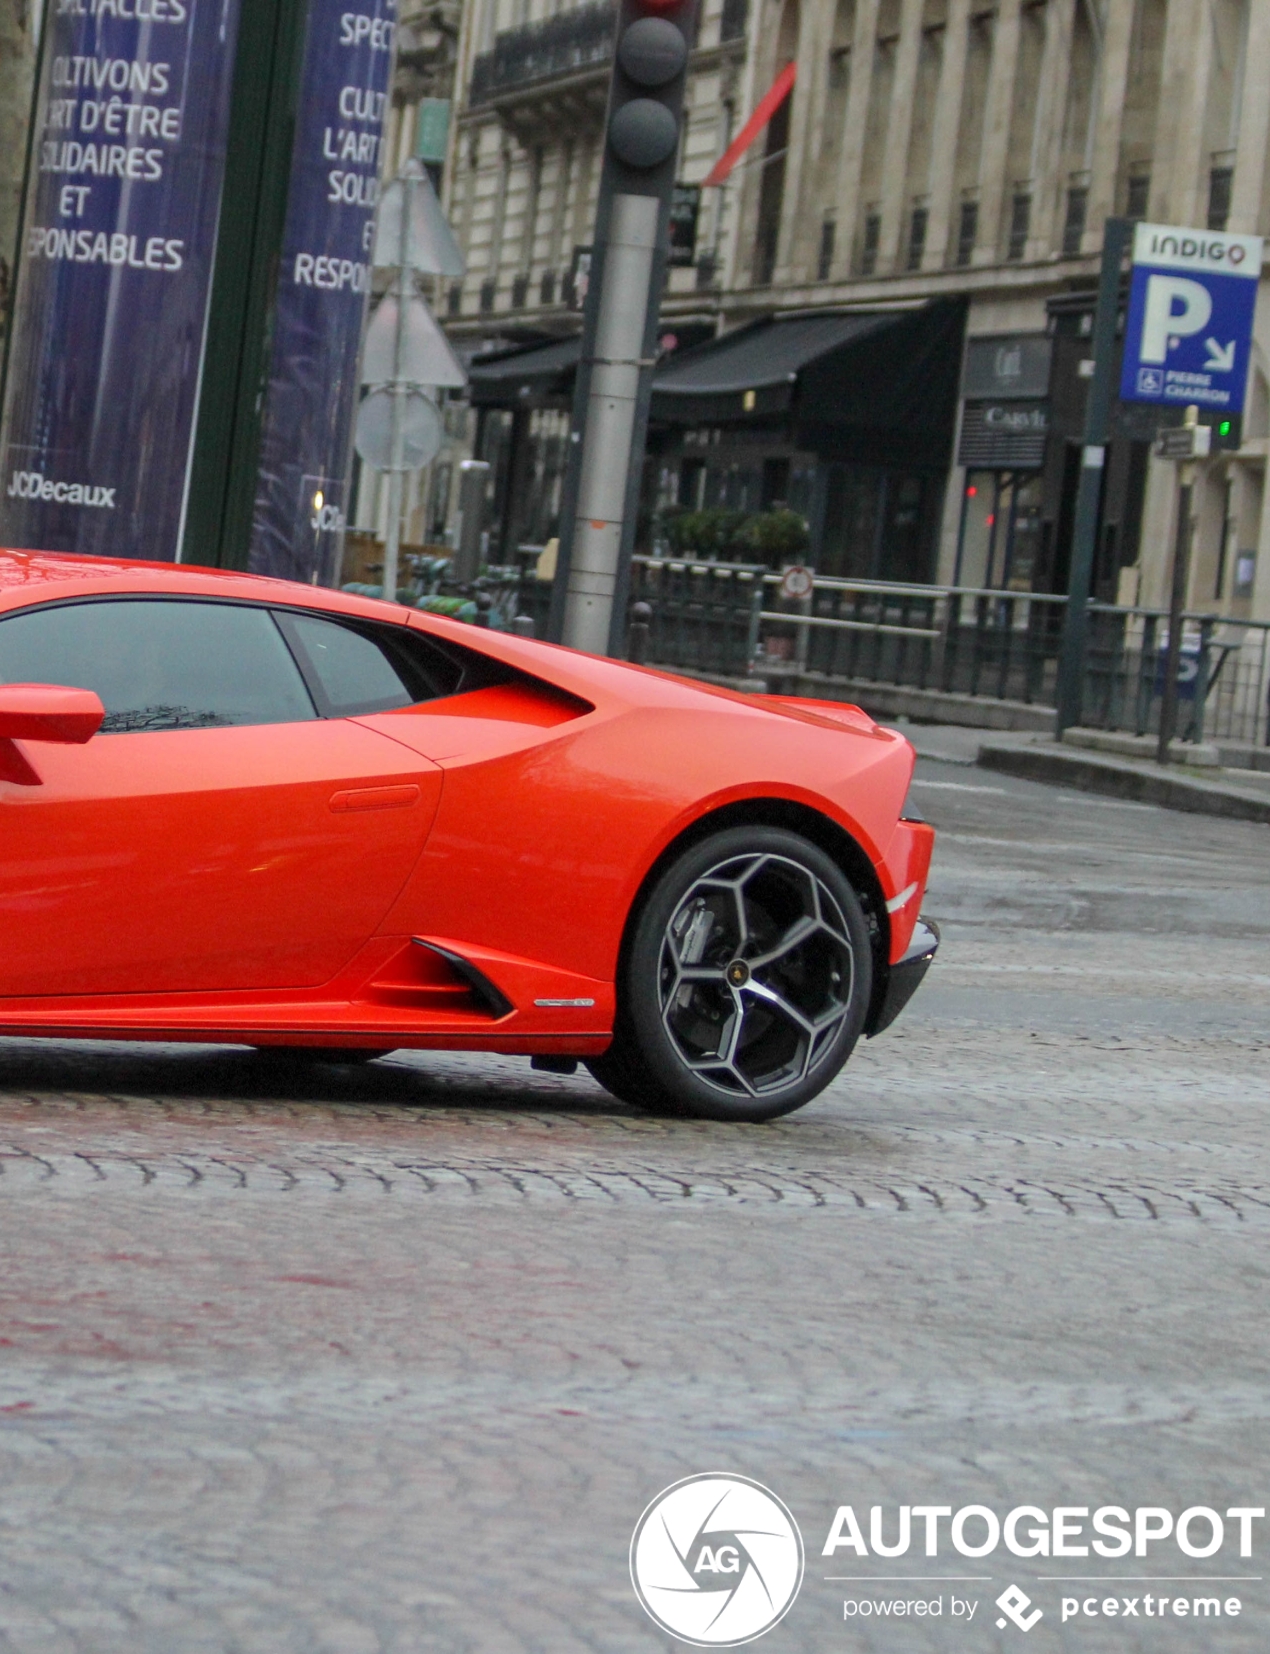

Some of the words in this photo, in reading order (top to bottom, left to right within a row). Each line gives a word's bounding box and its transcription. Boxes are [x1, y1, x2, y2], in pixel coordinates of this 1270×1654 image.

[81, 95, 180, 141] D'ÊTRE
[59, 184, 92, 218] ET
[1150, 235, 1246, 265] INDIGO
[1139, 274, 1213, 366] P
[1166, 370, 1212, 387] PIERRE
[7, 470, 117, 509] JCDecaux
